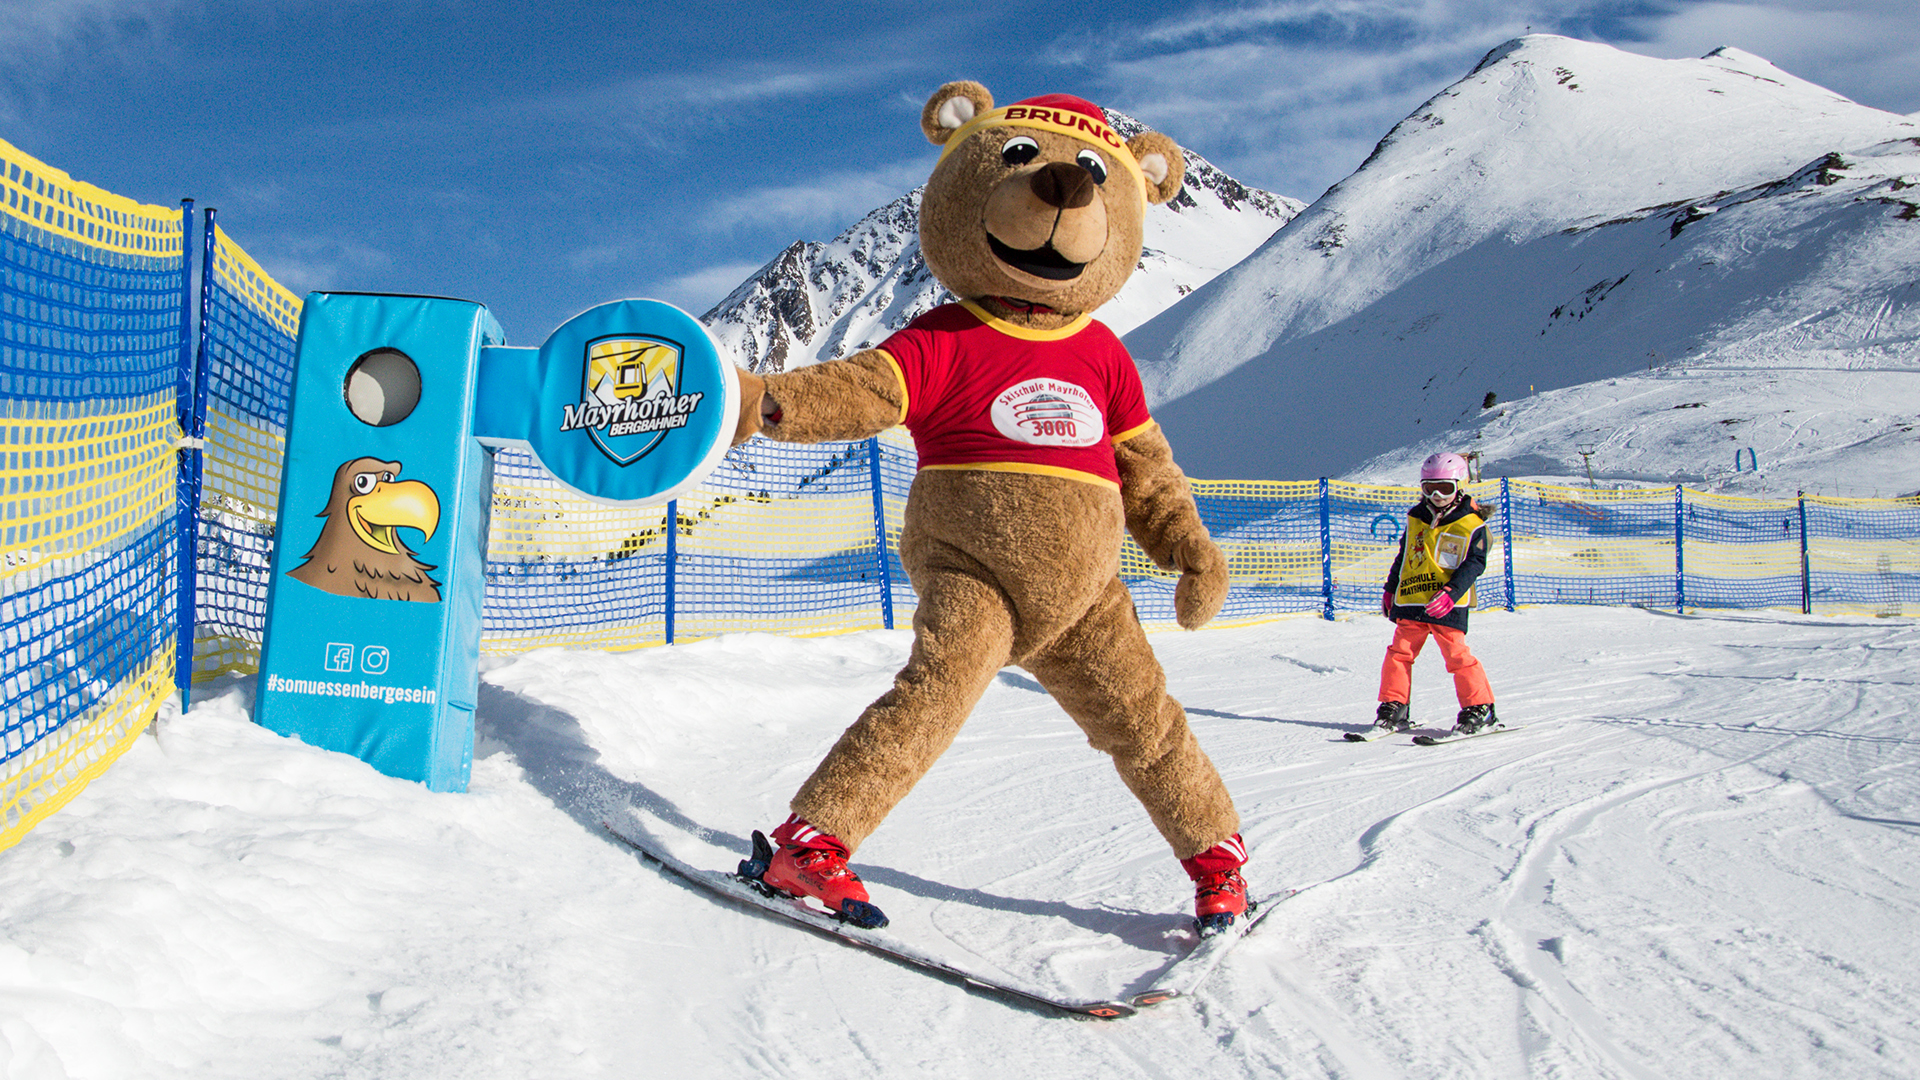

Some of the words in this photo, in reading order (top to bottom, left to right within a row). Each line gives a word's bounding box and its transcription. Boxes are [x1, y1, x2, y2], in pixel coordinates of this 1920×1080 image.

[1004, 107, 1121, 149] BRUNO
[1000, 382, 1044, 406] Skischule
[1048, 383, 1095, 410] Mayrhofen
[560, 390, 703, 432] Mayrhofner
[609, 413, 688, 437] BERGBAHNEN
[1031, 420, 1077, 438] 3000
[1400, 572, 1437, 588] SKISCHULE
[1400, 582, 1444, 597] MAYRHOFEN
[267, 674, 436, 704] #somuessenbergesein
